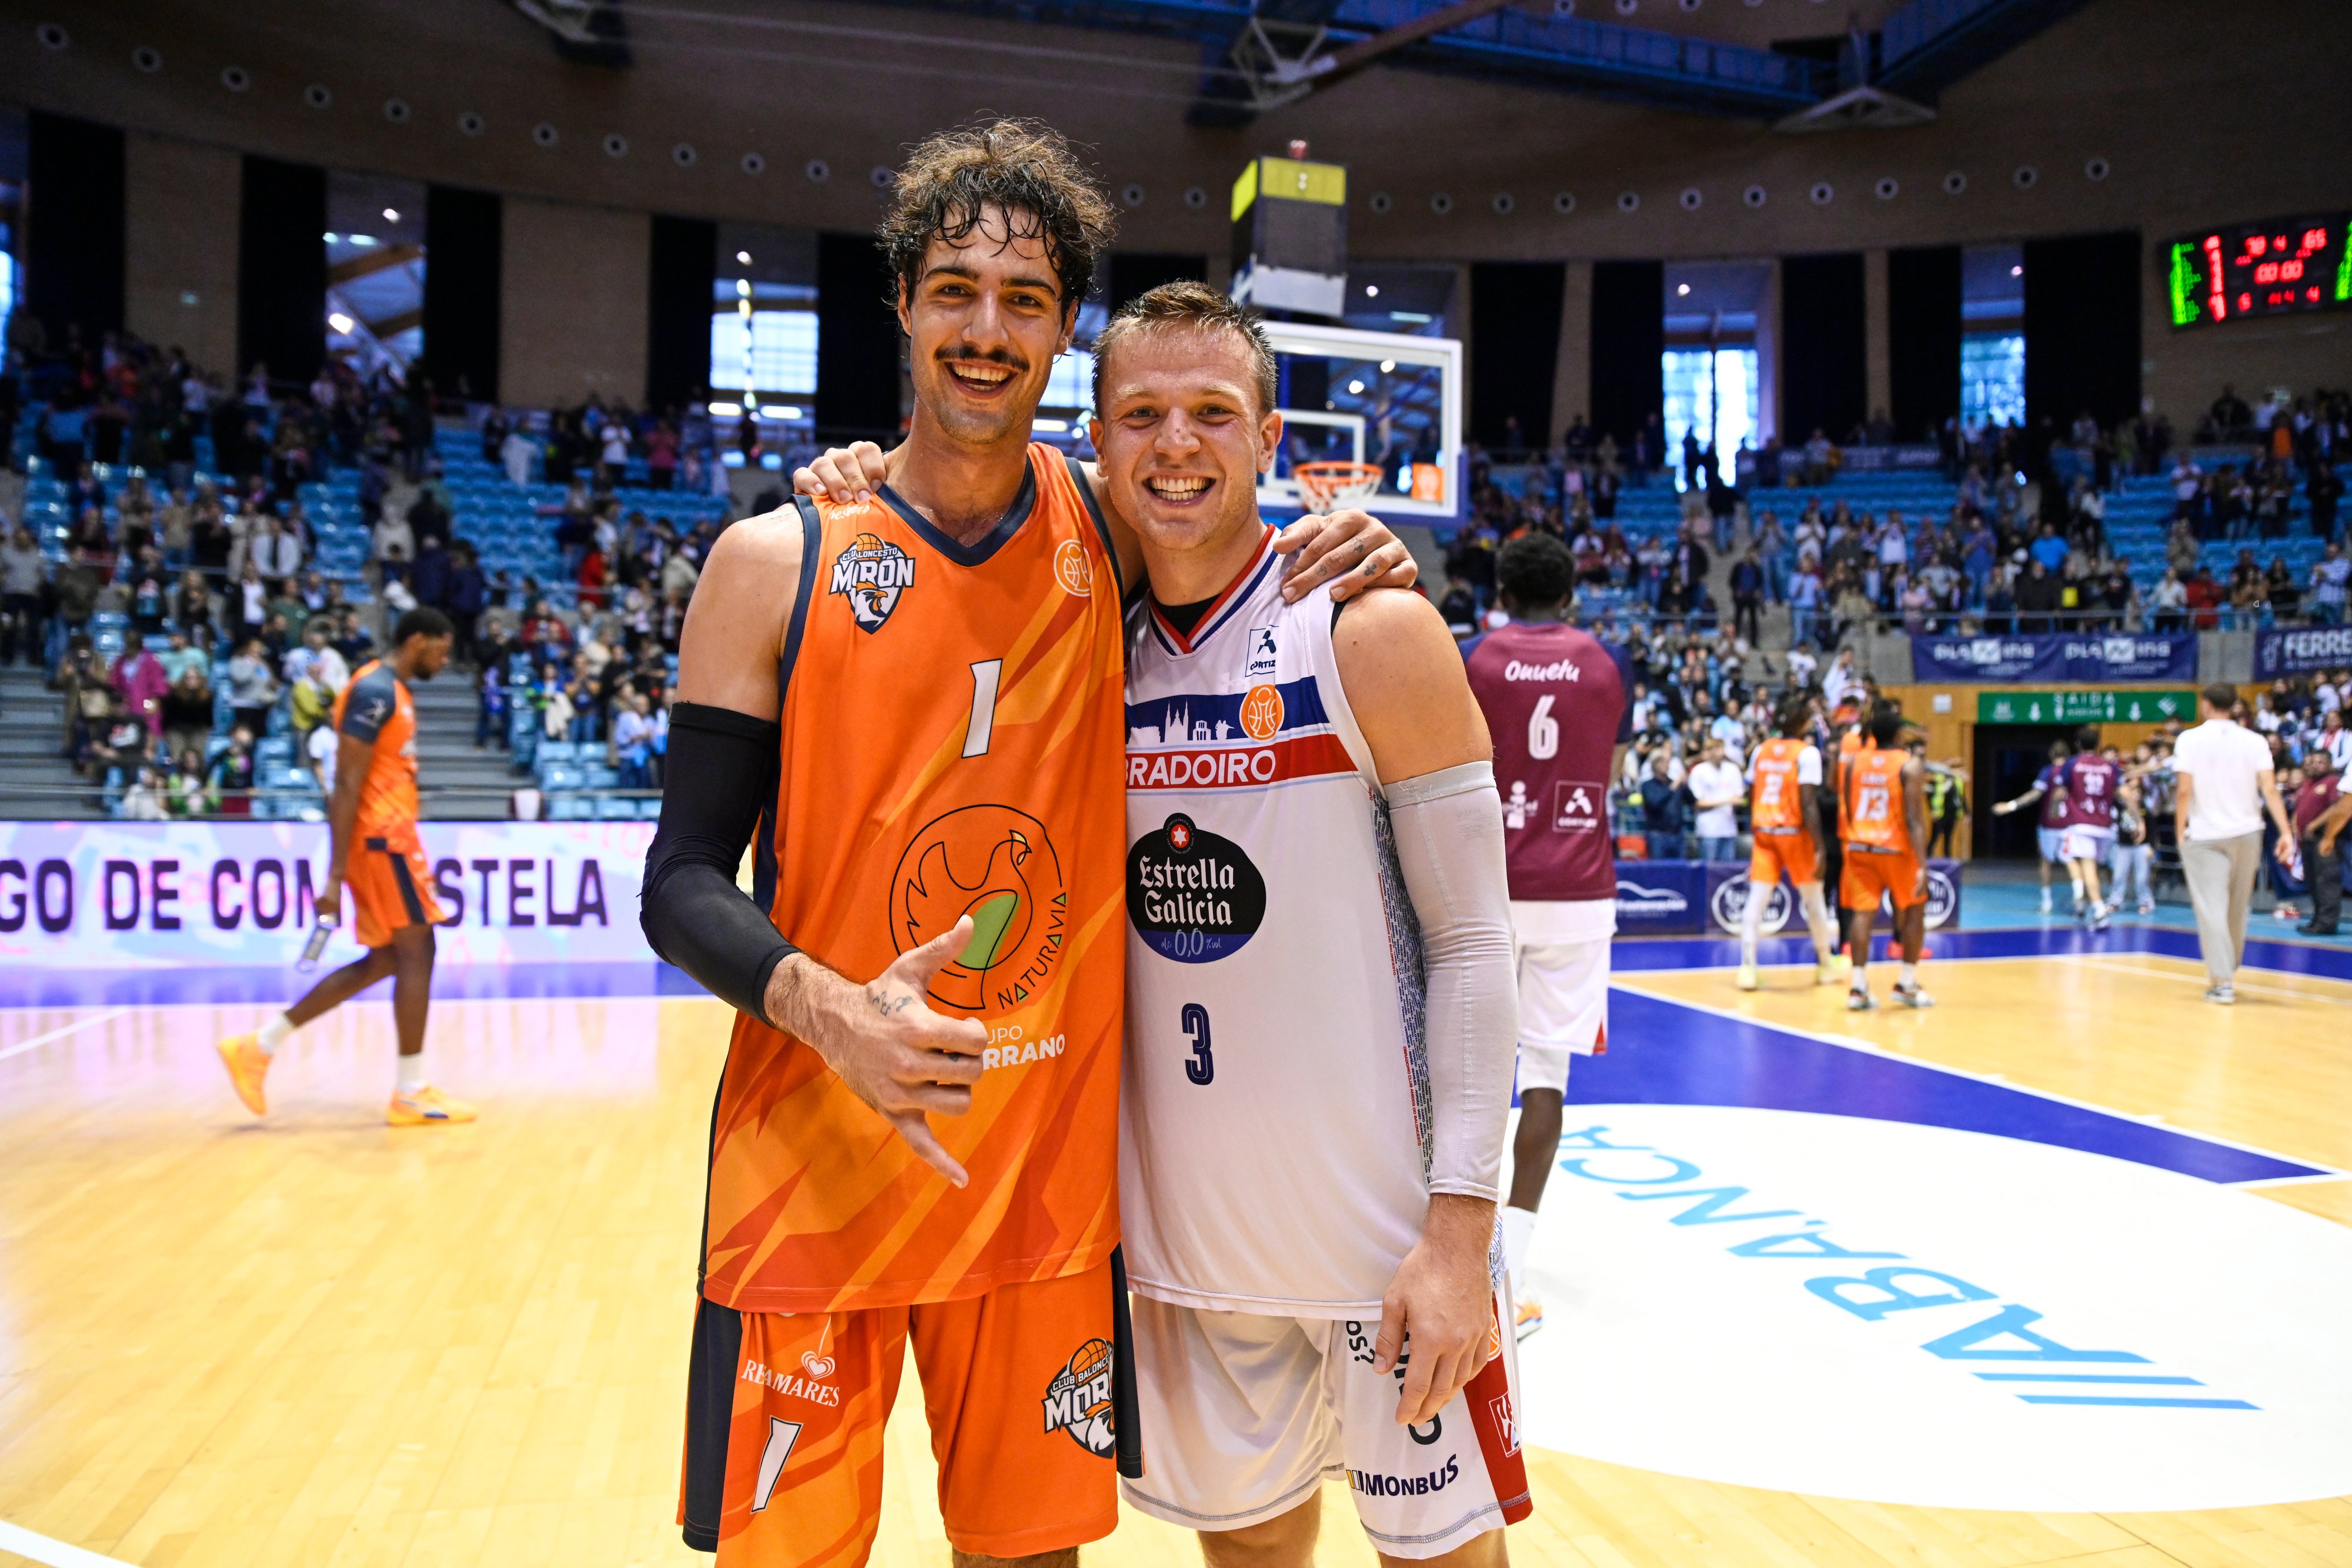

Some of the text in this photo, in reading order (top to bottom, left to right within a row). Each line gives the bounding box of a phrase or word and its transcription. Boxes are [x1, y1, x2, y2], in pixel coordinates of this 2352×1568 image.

[842, 550, 857, 561] CLU
[1250, 660, 1276, 670] CORTIZ
[961, 658, 1003, 758] 1
[1528, 694, 1559, 760] 6
[1125, 750, 1276, 787] RADOIRO
[1855, 787, 1890, 821] 13
[1139, 855, 1236, 890] Estrella
[105, 860, 181, 930] DE
[1144, 890, 1233, 926] Galicia
[997, 892, 1067, 1010] NATURAVIA
[1175, 928, 1204, 957] 0,0
[983, 1034, 1066, 1071] RRANO
[1181, 1002, 1214, 1086] 3
[1052, 1356, 1110, 1392] CLUB BALONCE
[1044, 1372, 1110, 1432] MOR
[750, 1415, 804, 1515] 1
[1365, 1453, 1459, 1497] MONBUS
